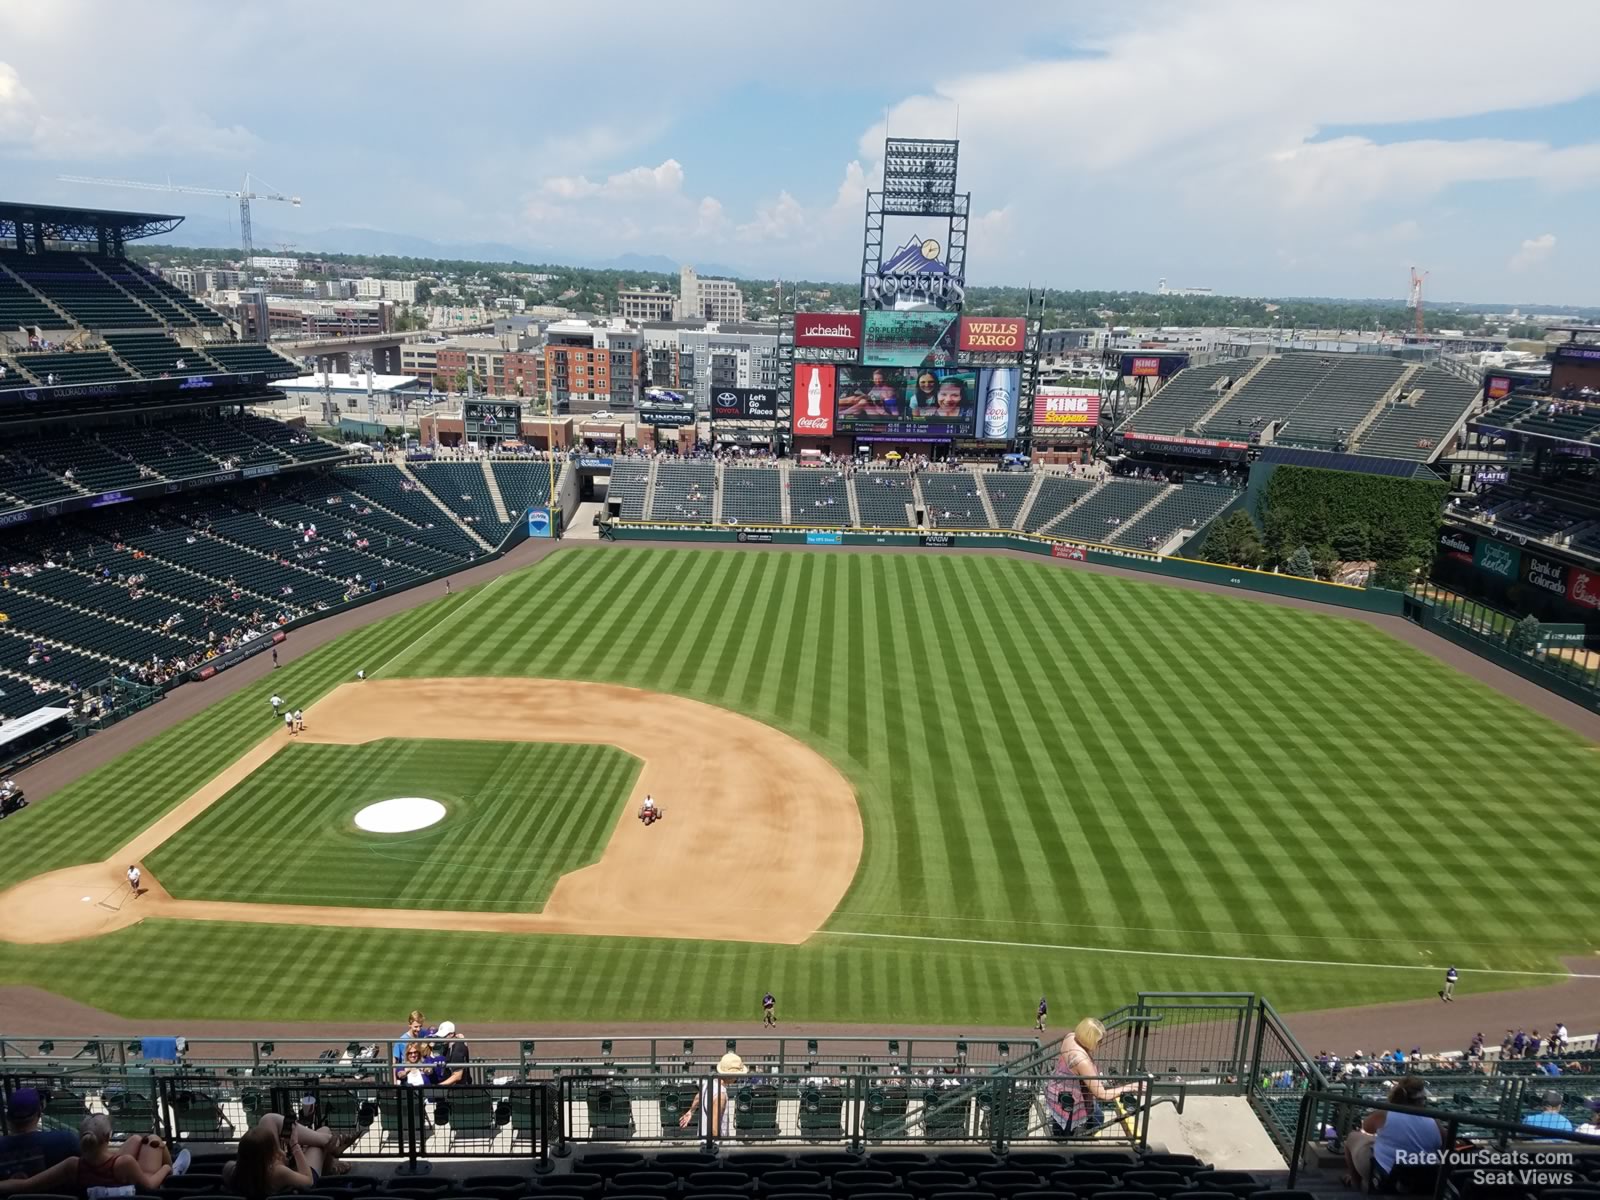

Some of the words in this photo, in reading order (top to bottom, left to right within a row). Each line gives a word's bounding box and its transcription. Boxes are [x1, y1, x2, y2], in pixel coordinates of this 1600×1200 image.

[861, 274, 965, 303] ROCKIES
[805, 324, 851, 336] uchealth
[968, 323, 1018, 334] WELLS
[968, 335, 1017, 347] FARGO
[1135, 360, 1157, 368] KING
[53, 387, 87, 397] COLORADO
[88, 384, 117, 394] ROCKIES
[1046, 398, 1088, 411] KING
[1045, 411, 1088, 425] Soopers
[1150, 443, 1182, 452] COLORADO
[1183, 447, 1211, 455] ROCKIES
[188, 478, 214, 487] COLORADO
[215, 474, 236, 482] ROCKIES
[1441, 535, 1470, 552] Safelite
[1481, 556, 1512, 575] dental
[1530, 558, 1550, 575] Bank
[1551, 566, 1562, 579] of
[1529, 571, 1566, 594] Colorado
